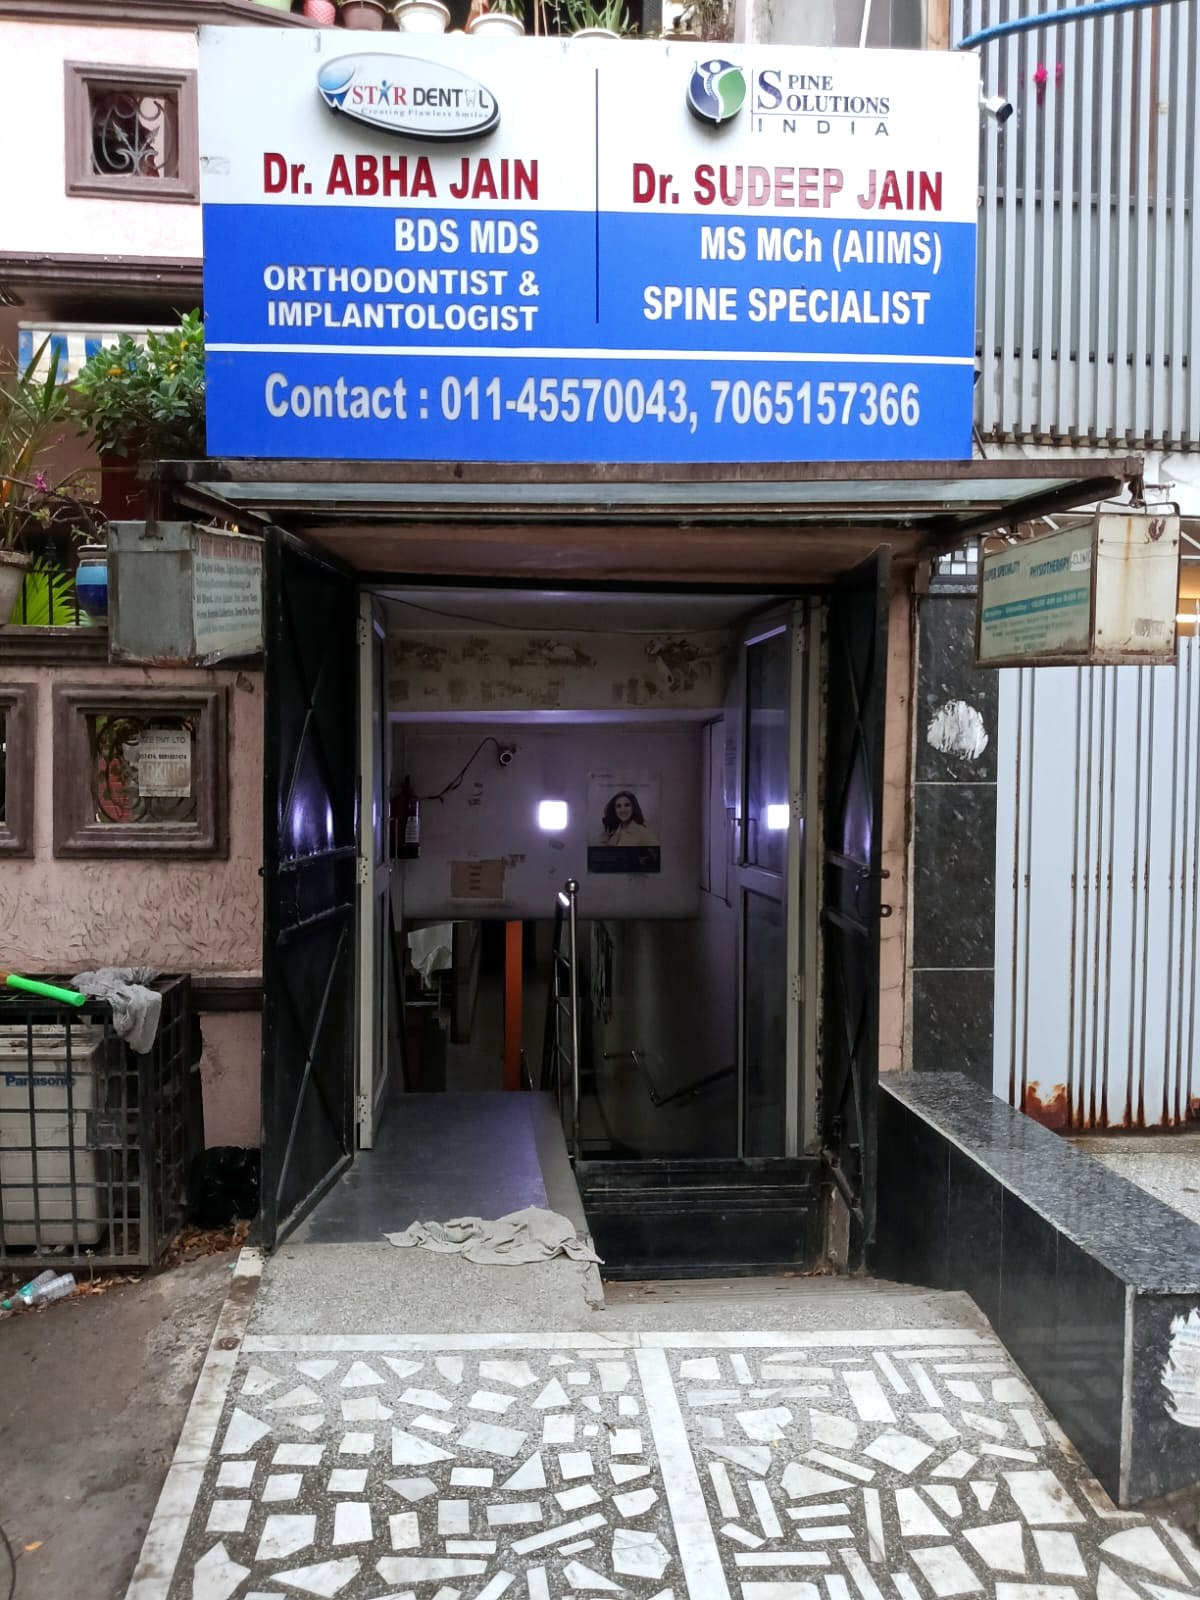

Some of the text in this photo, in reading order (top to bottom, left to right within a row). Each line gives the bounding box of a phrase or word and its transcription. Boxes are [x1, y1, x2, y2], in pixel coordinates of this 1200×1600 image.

[352, 80, 407, 106] STAR
[361, 108, 489, 119] Creating Flawless Smiles
[758, 118, 889, 136] INDIA
[263, 153, 539, 201] Dr. ABHA JAIN
[632, 163, 943, 212] Dr. SUDEEP JAIN
[394, 217, 539, 255] BDS MDS
[700, 226, 942, 274] MS MCh (AIIMS)
[263, 265, 540, 297] ORTHODONTIST &
[267, 301, 539, 332] IMPLANTOLOGIST
[643, 285, 931, 325] SPINE SPECIALIST
[265, 372, 407, 419] Contact
[441, 375, 698, 434] 011-45570043,
[710, 380, 921, 427] 7065157366
[172, 735, 186, 744] LTD
